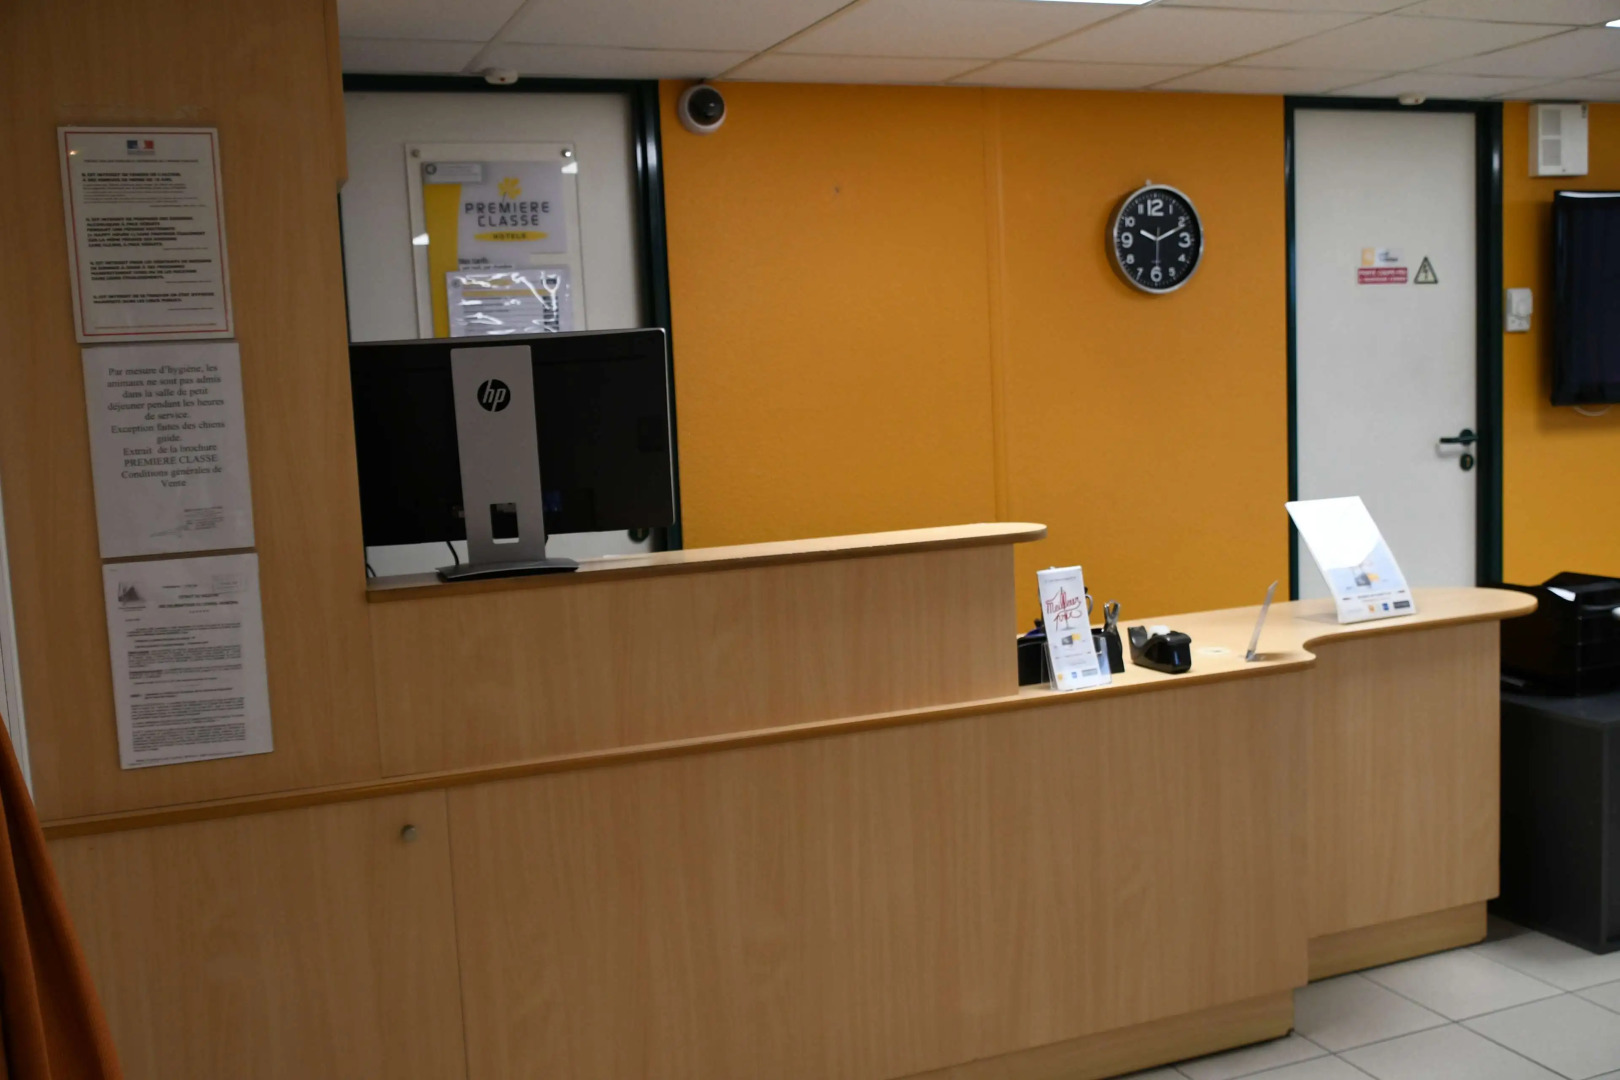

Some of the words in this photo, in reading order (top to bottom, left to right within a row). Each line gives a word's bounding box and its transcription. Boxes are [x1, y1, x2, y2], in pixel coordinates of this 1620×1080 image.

[465, 202, 550, 214] PREMIERE
[1147, 199, 1164, 216] 12
[478, 215, 539, 227] CLASSE
[1125, 216, 1135, 227] 10
[1178, 216, 1186, 228] 2
[1121, 232, 1133, 249] 9
[1178, 232, 1191, 248] 3
[1126, 254, 1134, 264] 8
[1178, 253, 1186, 262] 4
[1136, 267, 1143, 280] 7
[1150, 266, 1163, 282] 6
[1168, 267, 1176, 277] 5
[108, 367, 122, 376] Par
[125, 367, 157, 375] mesure
[206, 364, 218, 372] les
[107, 379, 144, 388] animaux
[160, 378, 178, 386] sont
[179, 378, 194, 388] pas
[196, 374, 221, 384] admis
[122, 390, 143, 399] dans
[145, 390, 153, 398] la
[154, 388, 175, 397] salle
[176, 387, 187, 396] de
[189, 386, 209, 398] petit
[482, 379, 507, 412] hp
[147, 399, 181, 411] pendant
[182, 399, 195, 407] les
[197, 397, 225, 407] heures
[144, 412, 155, 421] de
[111, 424, 154, 436] Exception
[181, 421, 196, 430] des
[198, 420, 226, 429] chiens
[123, 447, 152, 457] Extrait
[157, 446, 168, 454] de
[170, 445, 178, 454] la
[180, 442, 217, 453] brochure
[124, 456, 177, 467] PREMIERE
[178, 454, 218, 464] CLASSE
[121, 468, 168, 479] Conditions
[212, 464, 223, 474] de
[161, 478, 187, 488] Vente
